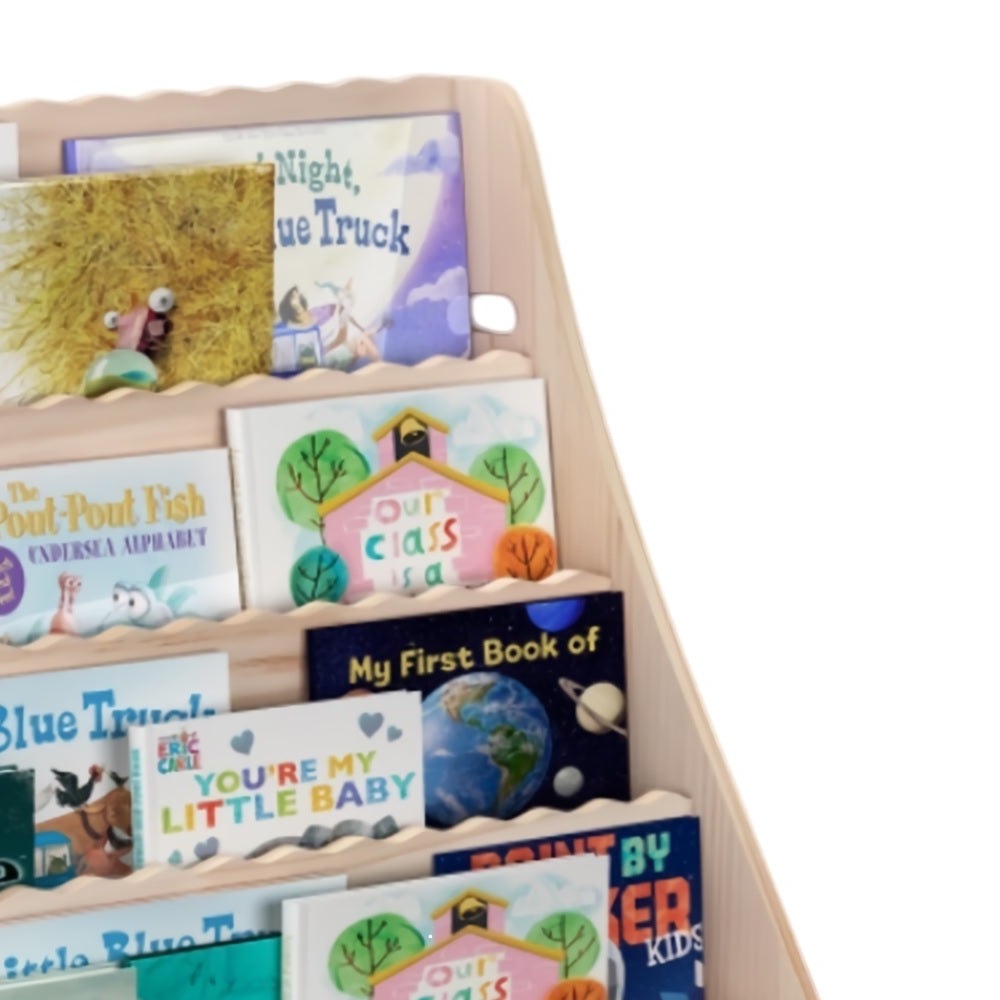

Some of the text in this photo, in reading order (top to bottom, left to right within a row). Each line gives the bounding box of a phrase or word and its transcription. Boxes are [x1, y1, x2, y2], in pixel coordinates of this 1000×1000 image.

[274, 149, 361, 196] Night,
[276, 197, 410, 256] ue Truck
[7, 481, 40, 503] The
[142, 482, 207, 524] Fish
[28, 527, 208, 564] UNDERSEA ALPHABET
[424, 562, 445, 589] a
[350, 626, 600, 688] My First Book of
[194, 750, 377, 797] YOU'RE MY
[161, 772, 416, 835] LITTLE BABY
[621, 831, 671, 878] BY
[645, 922, 702, 967] KIDS
